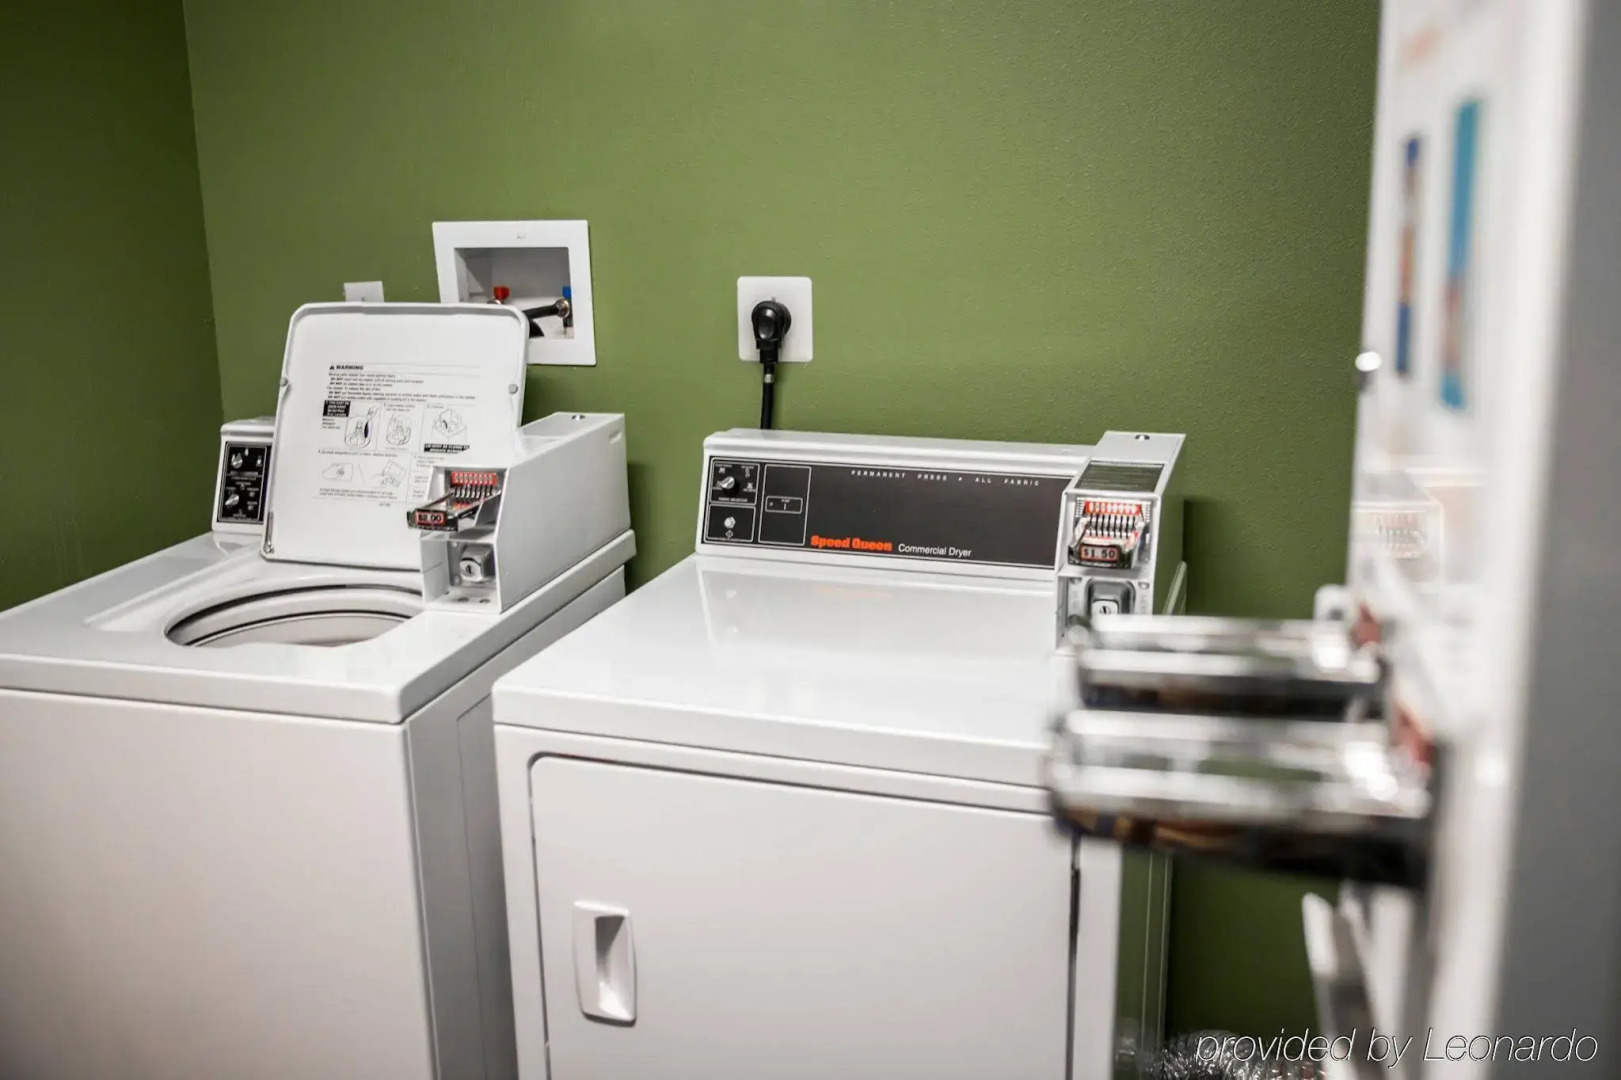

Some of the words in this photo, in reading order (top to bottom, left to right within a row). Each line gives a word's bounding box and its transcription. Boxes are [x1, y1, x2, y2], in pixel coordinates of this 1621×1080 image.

[851, 469, 906, 479] PERMANENT
[917, 473, 948, 482] PRESS
[974, 476, 992, 484] ALL
[1004, 478, 1040, 487] FABRIC
[810, 535, 850, 549] Speed
[851, 537, 893, 552] Queen
[898, 543, 947, 556] Commercial
[948, 547, 972, 558] Dryer
